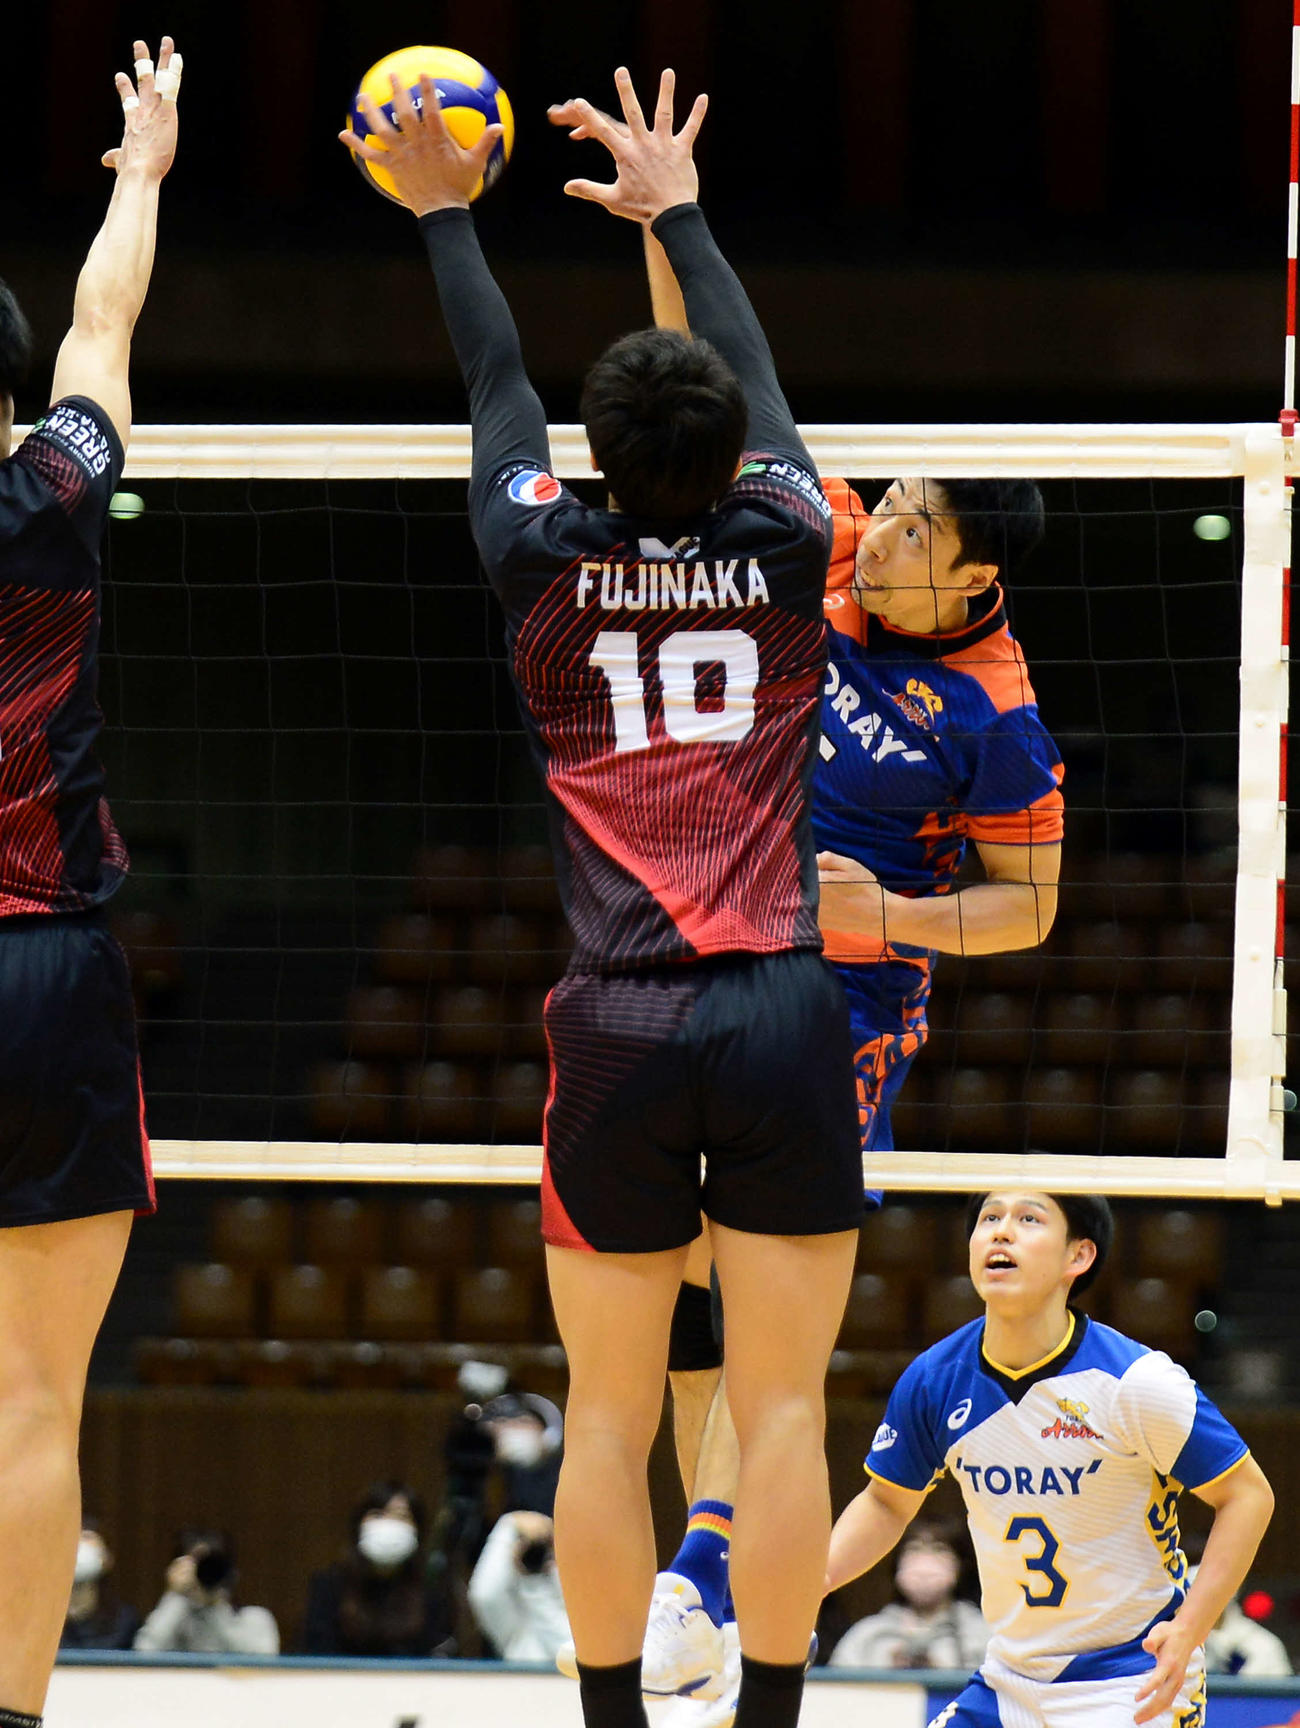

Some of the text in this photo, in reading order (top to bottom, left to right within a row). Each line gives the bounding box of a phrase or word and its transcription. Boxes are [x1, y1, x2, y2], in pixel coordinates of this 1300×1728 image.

[44, 414, 107, 475] GREEN
[577, 557, 770, 610] FUJINAKA
[588, 629, 760, 753] 10
[1003, 1512, 1072, 1609] 3
